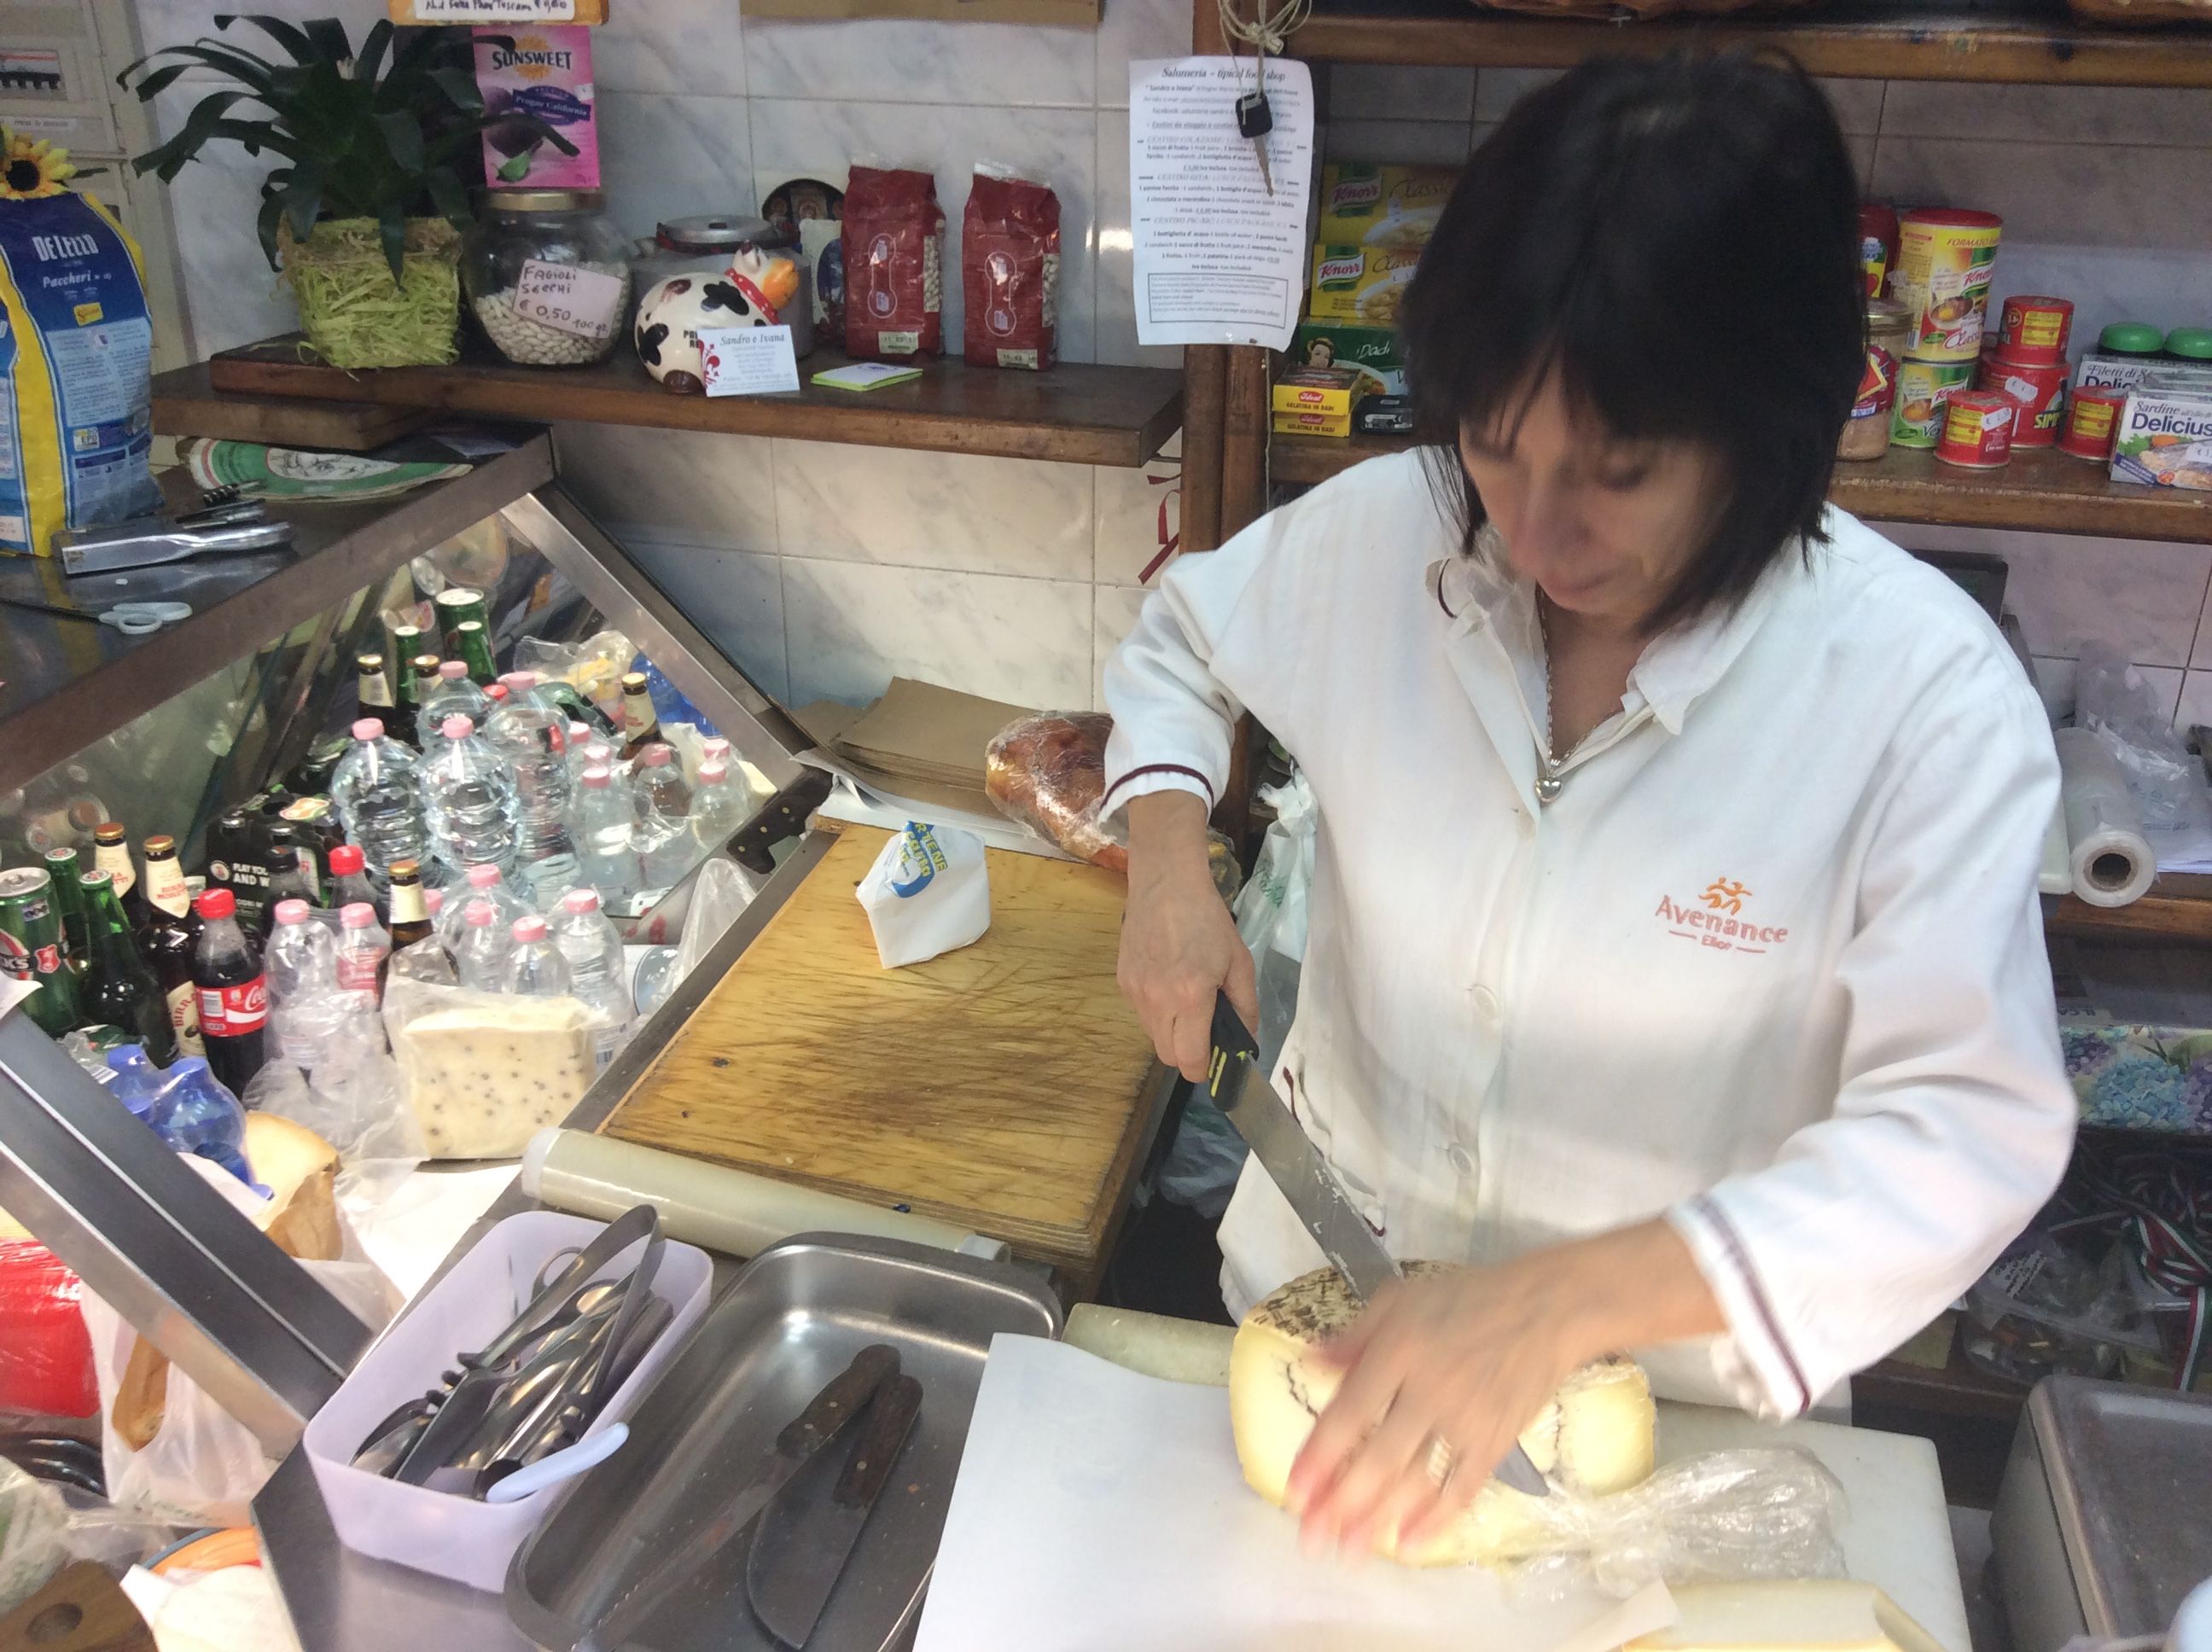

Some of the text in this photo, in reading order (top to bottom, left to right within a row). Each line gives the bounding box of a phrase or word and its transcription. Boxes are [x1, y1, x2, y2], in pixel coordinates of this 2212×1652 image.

[492, 50, 573, 71] SUNSWEET
[1161, 67, 1207, 78] Salumeria
[1245, 67, 1265, 79] foo
[1266, 69, 1286, 82] shop
[1332, 184, 1380, 203] Knorr
[43, 269, 91, 288] Paccheri
[1319, 263, 1360, 279] Knorr
[720, 333, 751, 346] Sandro
[760, 334, 785, 343] Ivana
[1359, 340, 1393, 359] Dadi
[2087, 364, 2124, 377] Filetti
[2125, 367, 2137, 378] di
[2134, 400, 2181, 415] Sardine
[2131, 413, 2212, 437] Delicius
[233, 873, 257, 886] AND
[1655, 894, 1789, 943] Avenance
